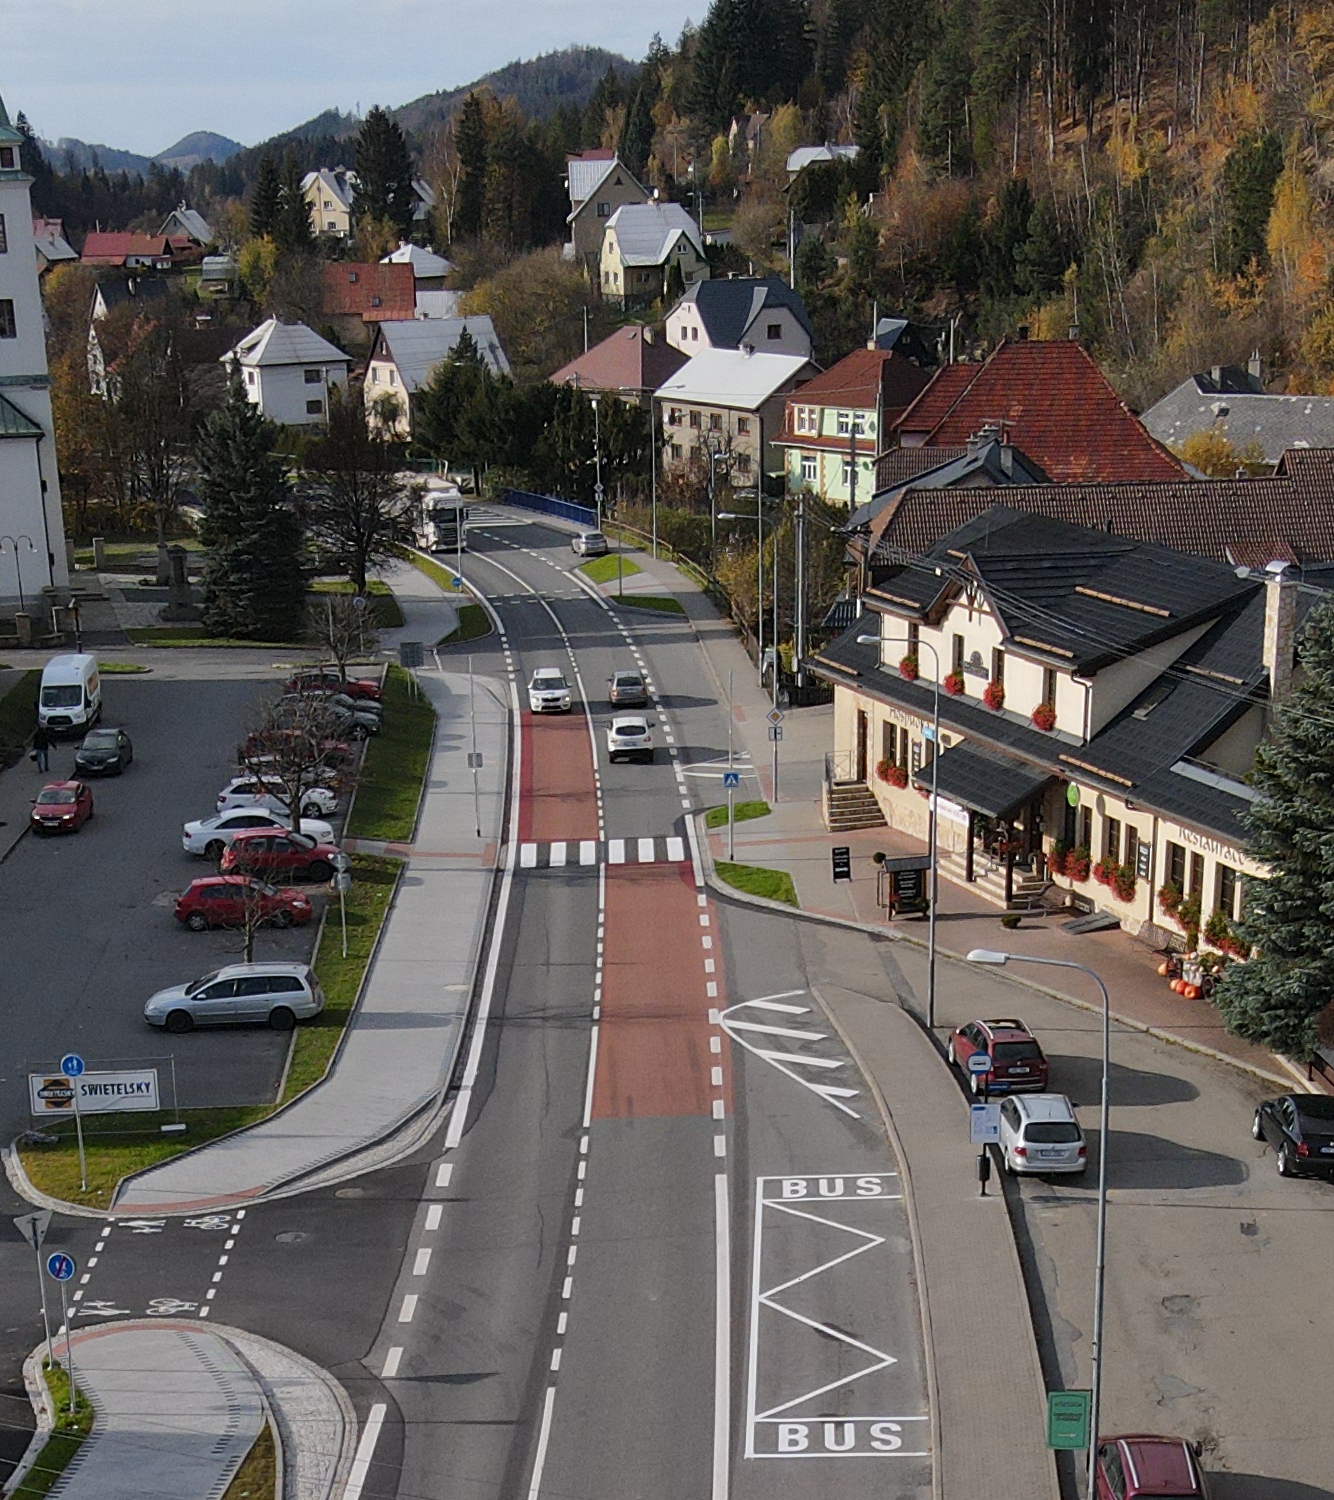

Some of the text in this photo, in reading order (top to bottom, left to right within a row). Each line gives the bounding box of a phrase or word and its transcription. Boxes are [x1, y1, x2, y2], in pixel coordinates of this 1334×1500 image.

[80, 1081, 151, 1097] SWIETELSKY
[781, 1177, 883, 1199] BUS
[777, 1422, 903, 1453] BUS
